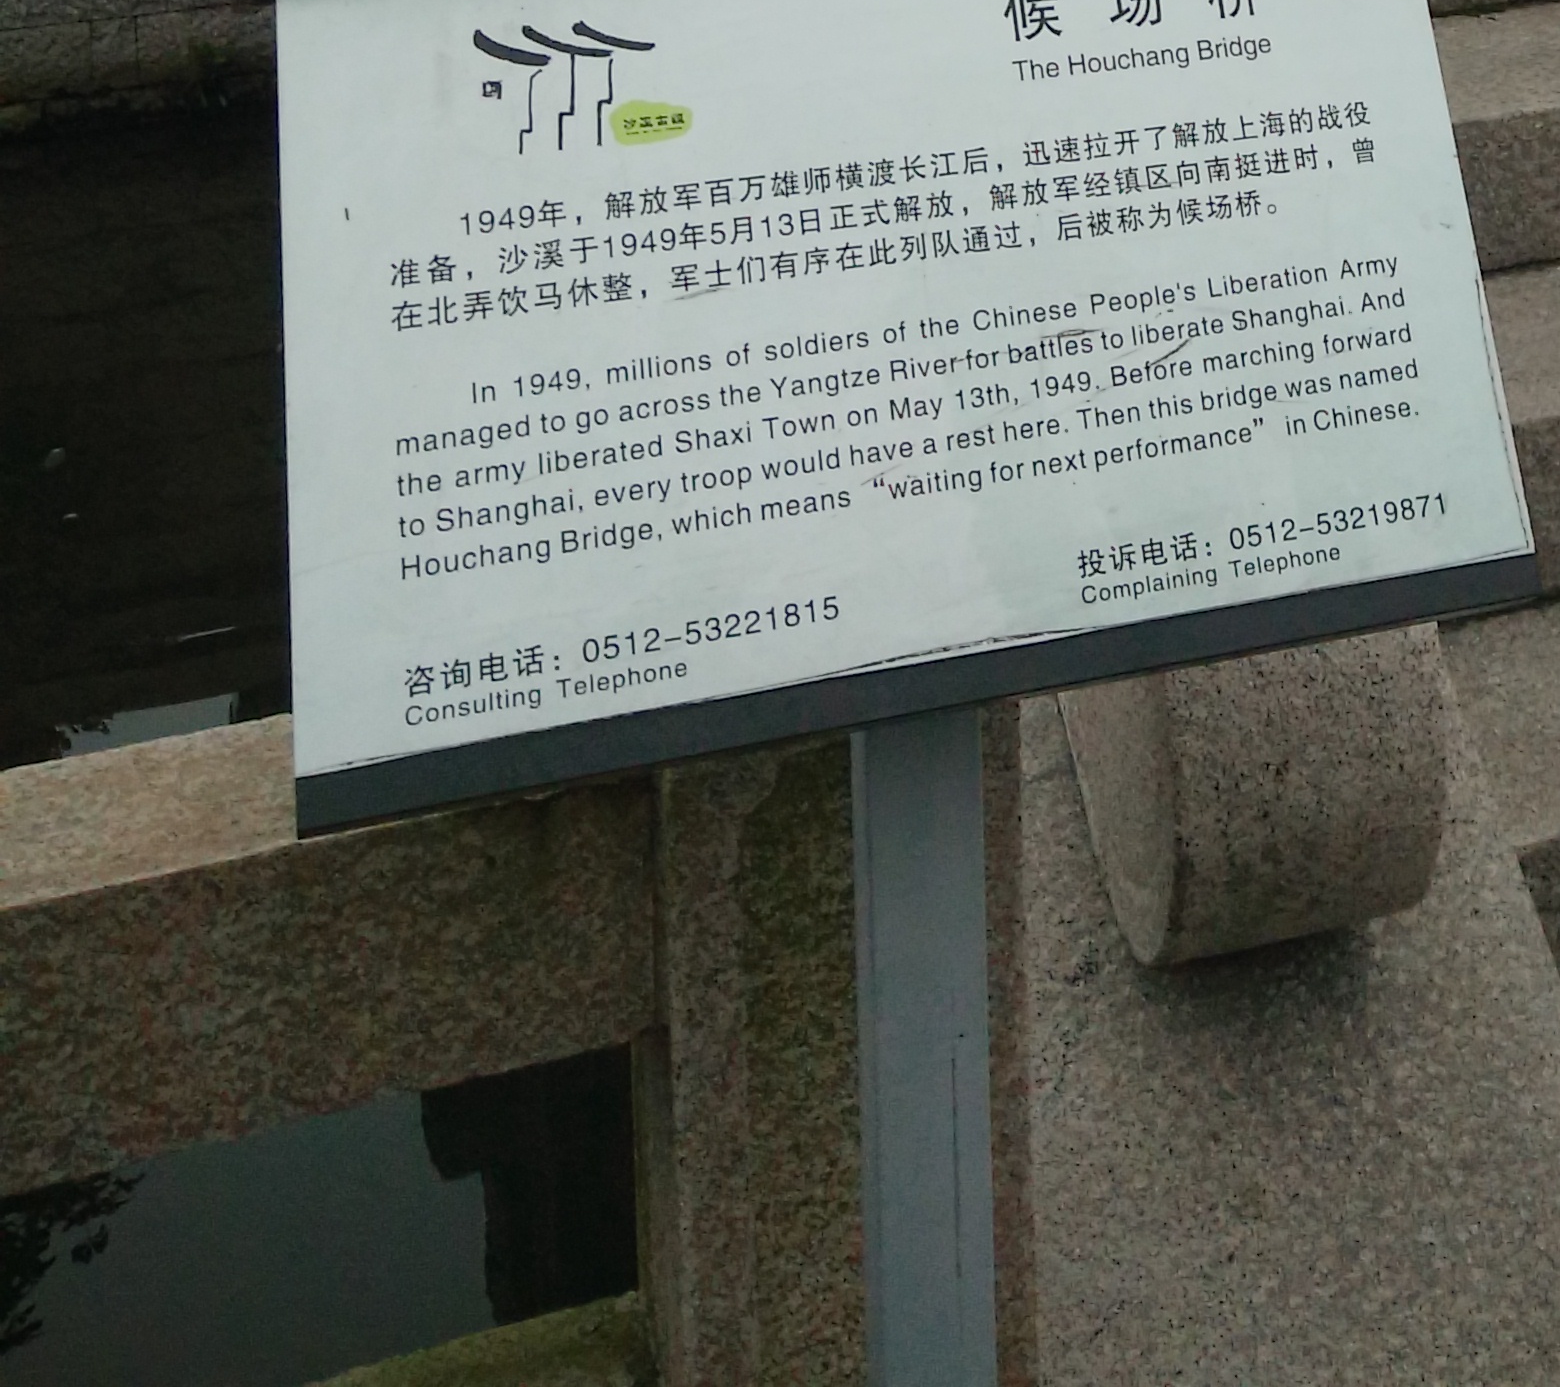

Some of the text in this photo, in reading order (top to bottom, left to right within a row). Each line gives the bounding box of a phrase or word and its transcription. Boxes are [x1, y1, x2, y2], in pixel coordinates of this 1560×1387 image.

[1013, 33, 1271, 82] The Houchang Bridge
[395, 287, 1405, 456] managed to go across the Yangtze River for battles to liberate Shanghai. And
[470, 257, 1398, 404] In 1949, millions of soldiers of the Chinese People's Liberation Army
[397, 324, 1412, 497] the army liberated Shaxi Town on May 13th, 1949. Before marching forward
[398, 360, 1419, 538] to Shanghai, every troop would have a rest here. Then this bridge was named
[400, 537, 551, 580] Houchang
[561, 521, 663, 554] Bridge,
[671, 502, 752, 535] which
[761, 489, 851, 522] means
[989, 461, 1024, 484] for
[1032, 448, 1087, 477] next
[1285, 415, 1307, 435] in
[1313, 399, 1420, 431] Chinese.
[1081, 545, 1341, 604] Complaining Telephone
[404, 660, 688, 726] Consulting Telephone
